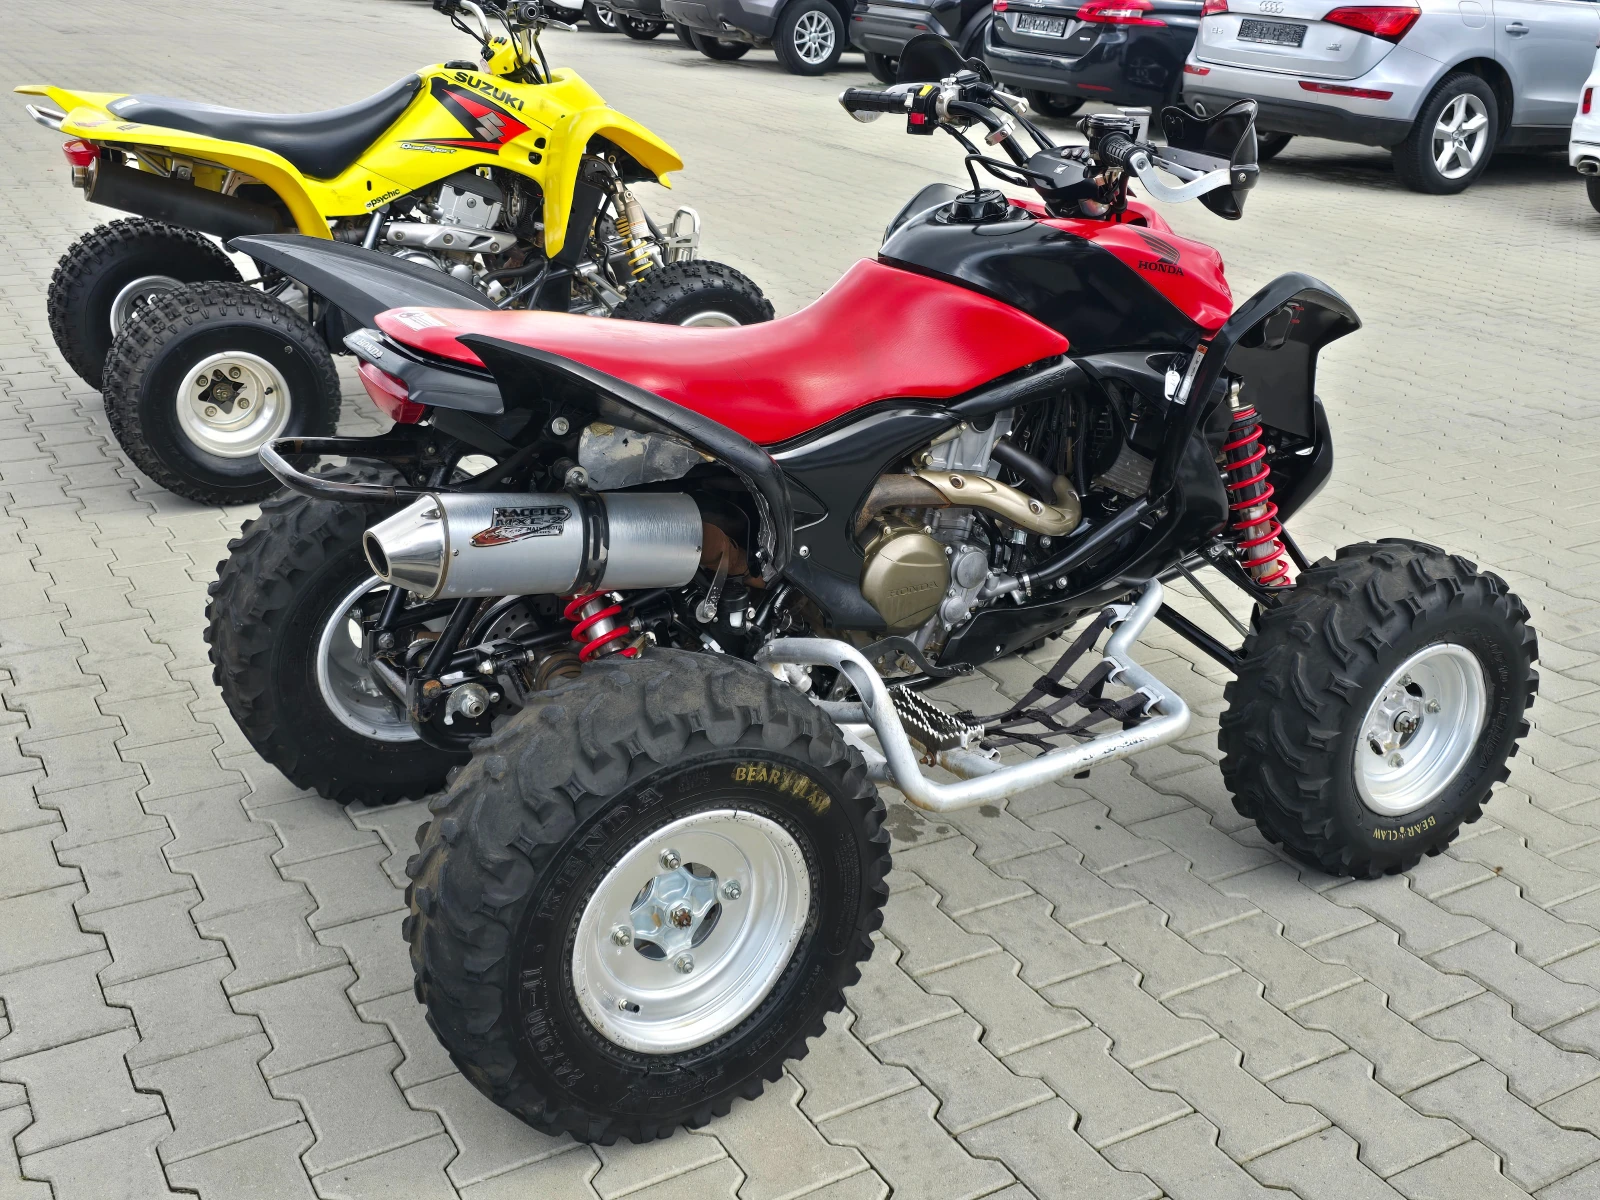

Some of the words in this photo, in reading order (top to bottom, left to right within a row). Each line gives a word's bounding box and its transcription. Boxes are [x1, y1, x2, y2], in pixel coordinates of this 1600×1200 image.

[454, 72, 524, 111] SUZUKI
[370, 188, 400, 207] psychic
[1138, 260, 1184, 276] HONDA
[357, 339, 384, 359] HONDA
[887, 581, 939, 598] HONDA
[735, 767, 781, 785] BEAR
[1373, 828, 1398, 840] CLAW
[1407, 815, 1436, 837] BEAR
[538, 787, 664, 921] KENDA
